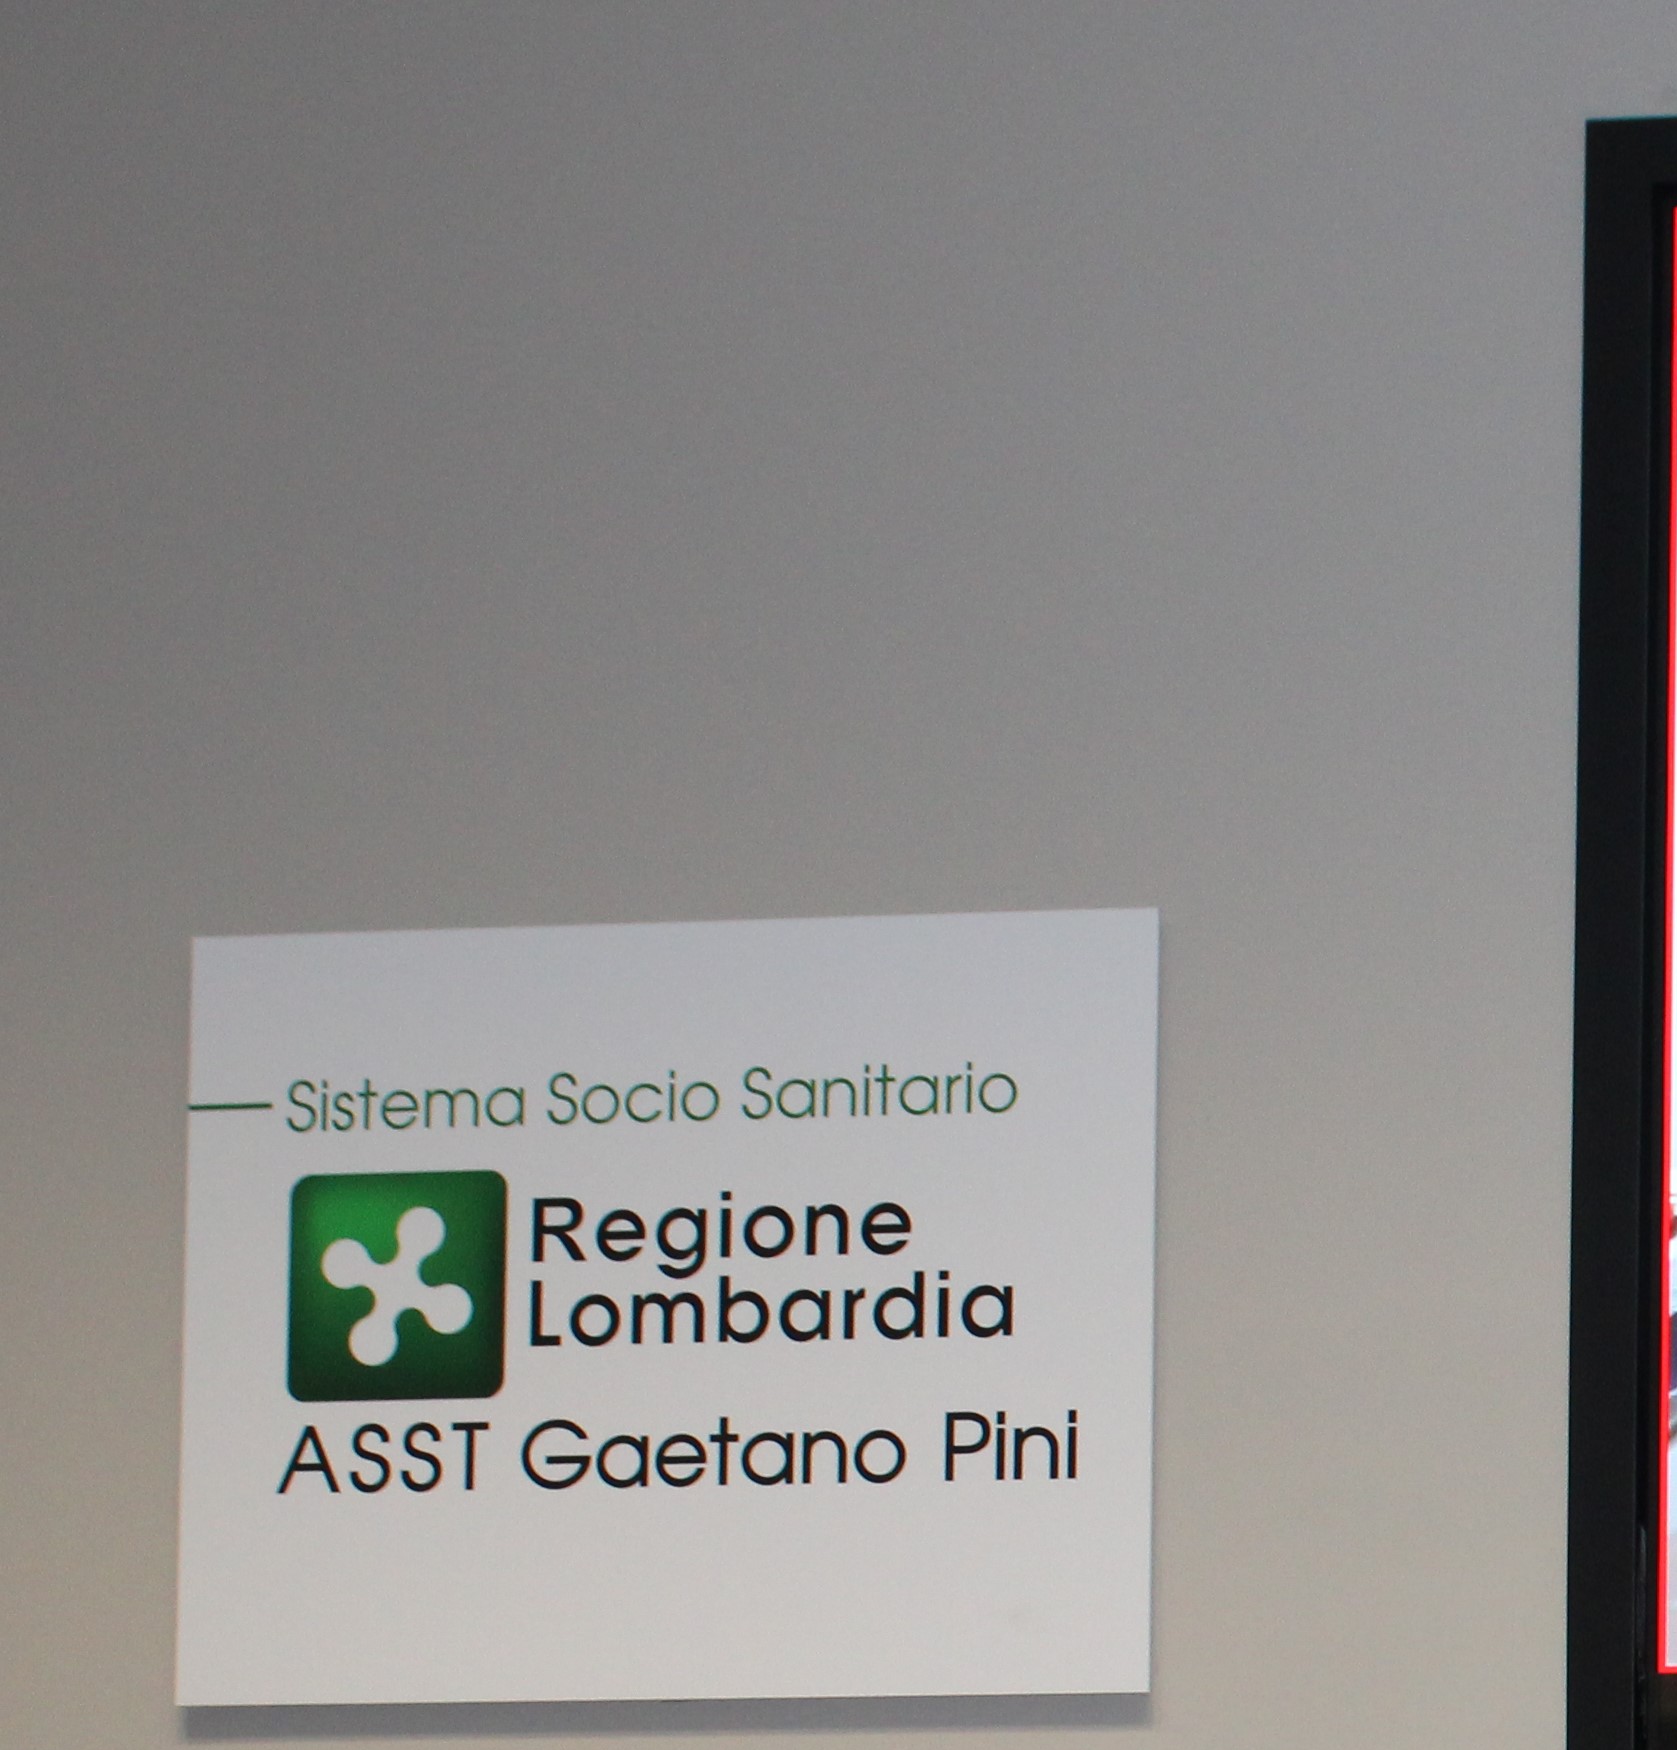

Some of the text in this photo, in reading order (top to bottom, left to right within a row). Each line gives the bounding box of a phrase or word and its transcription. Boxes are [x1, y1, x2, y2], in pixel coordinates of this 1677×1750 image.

[285, 1061, 1019, 1134] Sistema Socio Sanitario
[531, 1190, 913, 1280] Regione
[528, 1271, 1015, 1347] Lombardia
[276, 1409, 1078, 1495] ASST Gaetano Pini
